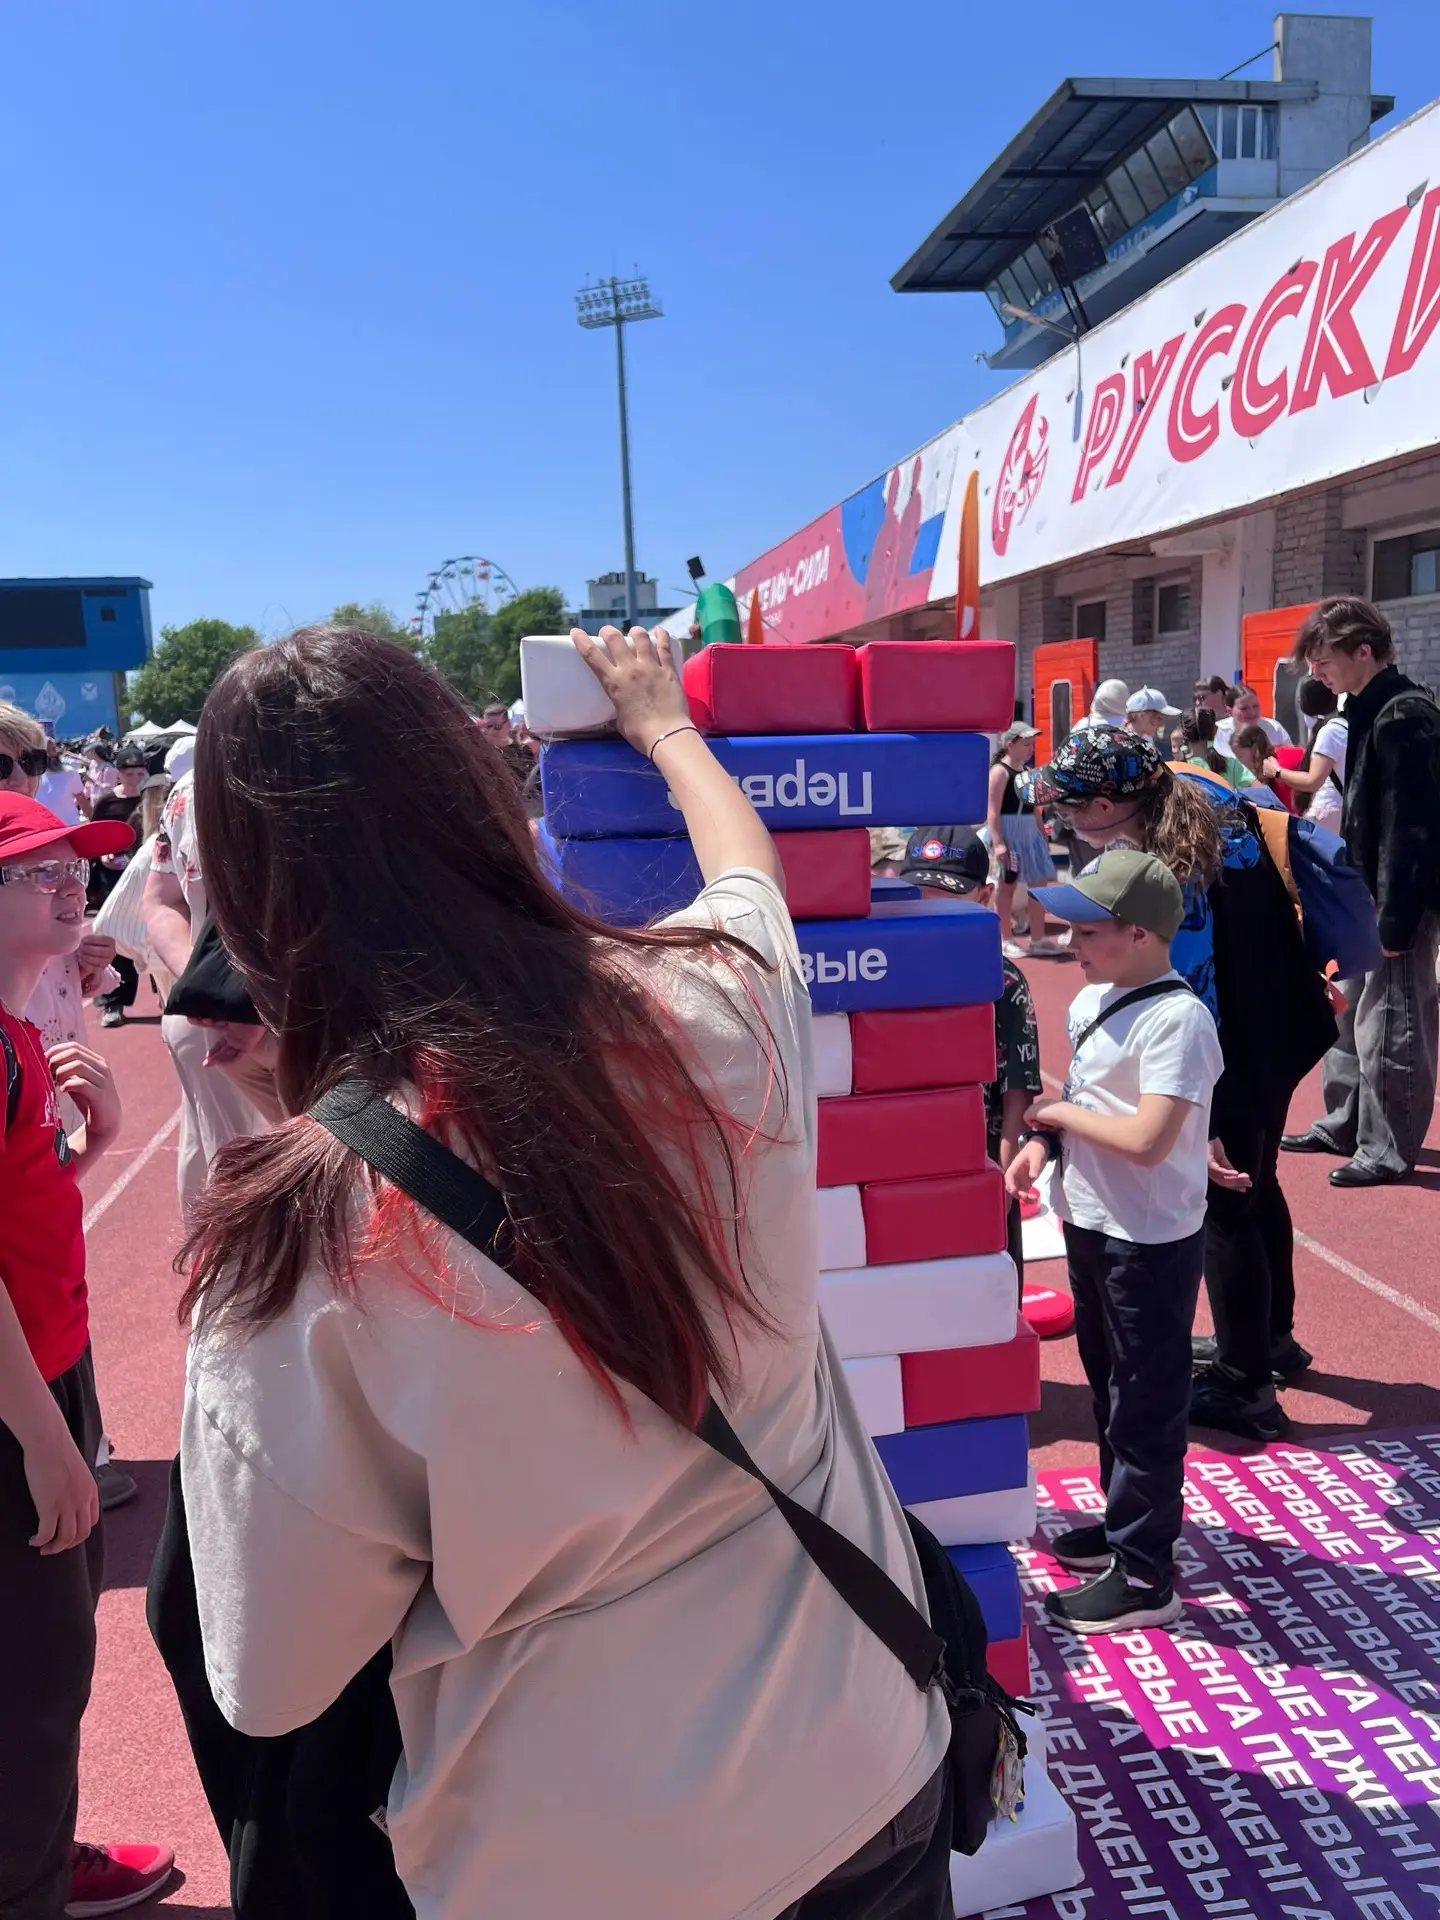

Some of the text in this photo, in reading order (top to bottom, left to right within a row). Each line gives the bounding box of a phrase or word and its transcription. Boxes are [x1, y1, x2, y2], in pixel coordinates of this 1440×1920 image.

[667, 758, 873, 816] Перв
[799, 947, 888, 985] вые
[1239, 1453, 1365, 1559] ПЕРВЫЕ
[1334, 1560, 1440, 1665] ДЖЕН
[1276, 1450, 1408, 1554] ДЖЕНГА
[1181, 1475, 1264, 1571] ЕРВЫЕ
[1232, 1574, 1380, 1714] ДЖЕНГА
[1188, 1460, 1440, 1705] ДЖЕНГА ПЕРВЫЕ
[1188, 1580, 1328, 1721] ПЕРВЫЕ
[1108, 1630, 1209, 1738] РВЫЕ
[1162, 1608, 1414, 1920] ЖЕНГА ПЕРВЫЕ
[1048, 1760, 1181, 1920] ДЖЕНГ
[1119, 1750, 1262, 1920] ПЕРВЫ
